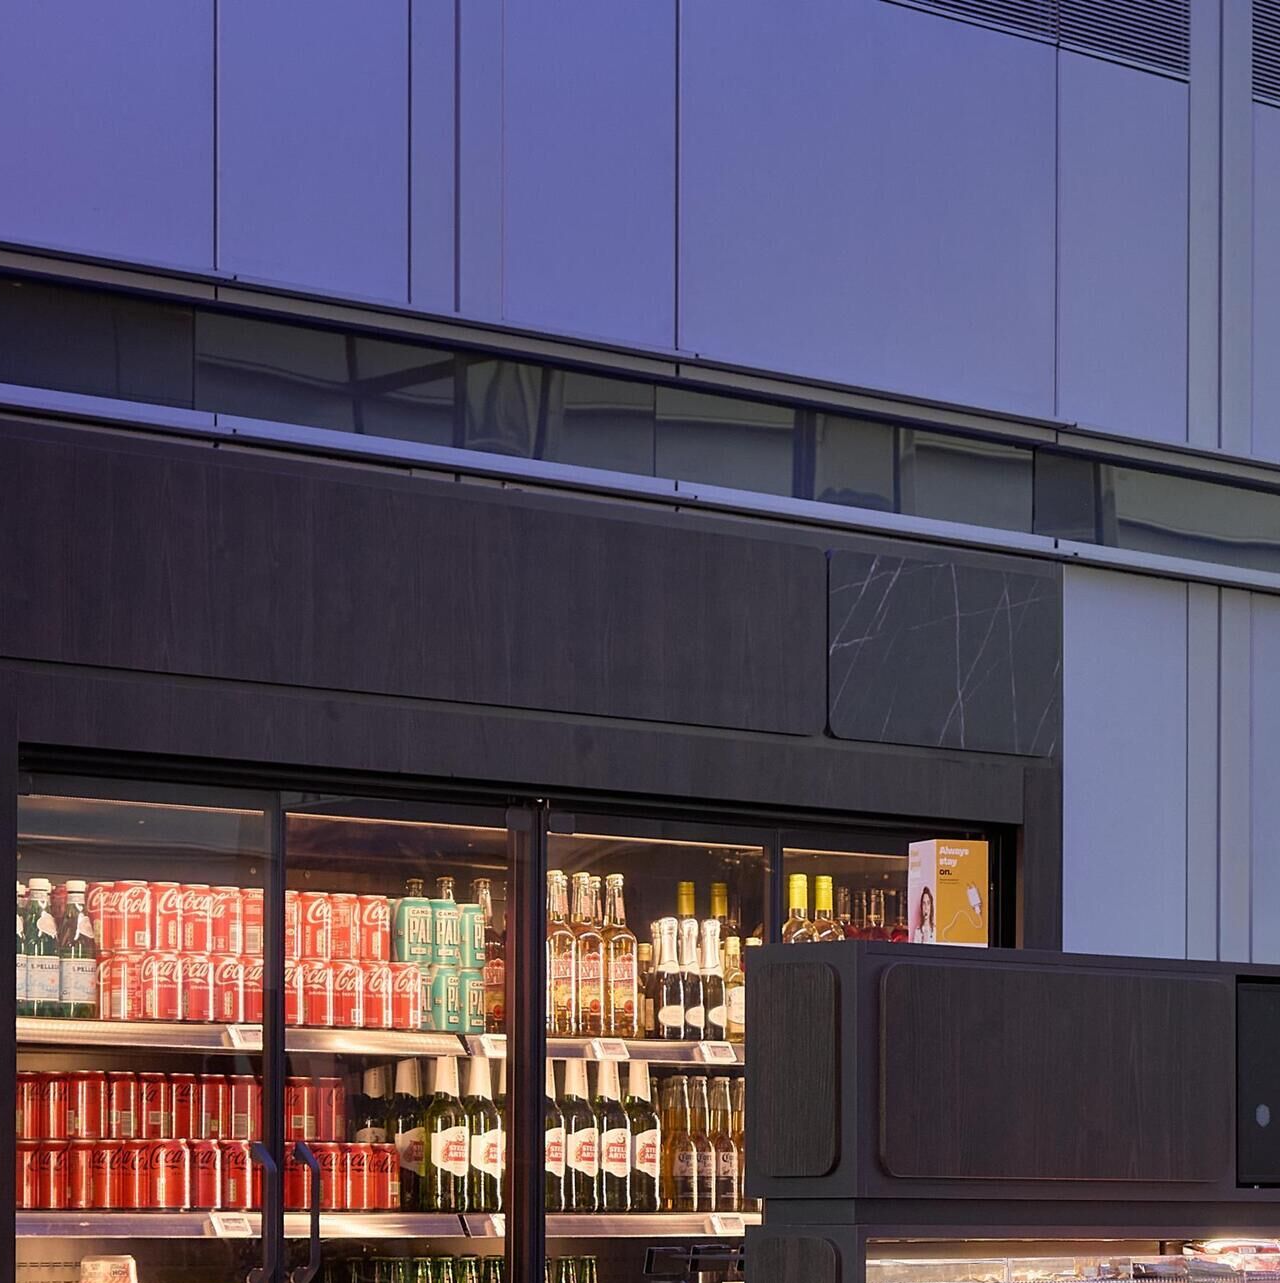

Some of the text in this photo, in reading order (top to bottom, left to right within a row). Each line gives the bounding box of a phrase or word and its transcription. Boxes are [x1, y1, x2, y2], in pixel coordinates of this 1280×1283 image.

[939, 846, 969, 857] Always
[939, 857, 958, 867] stay
[939, 868, 952, 876] on.
